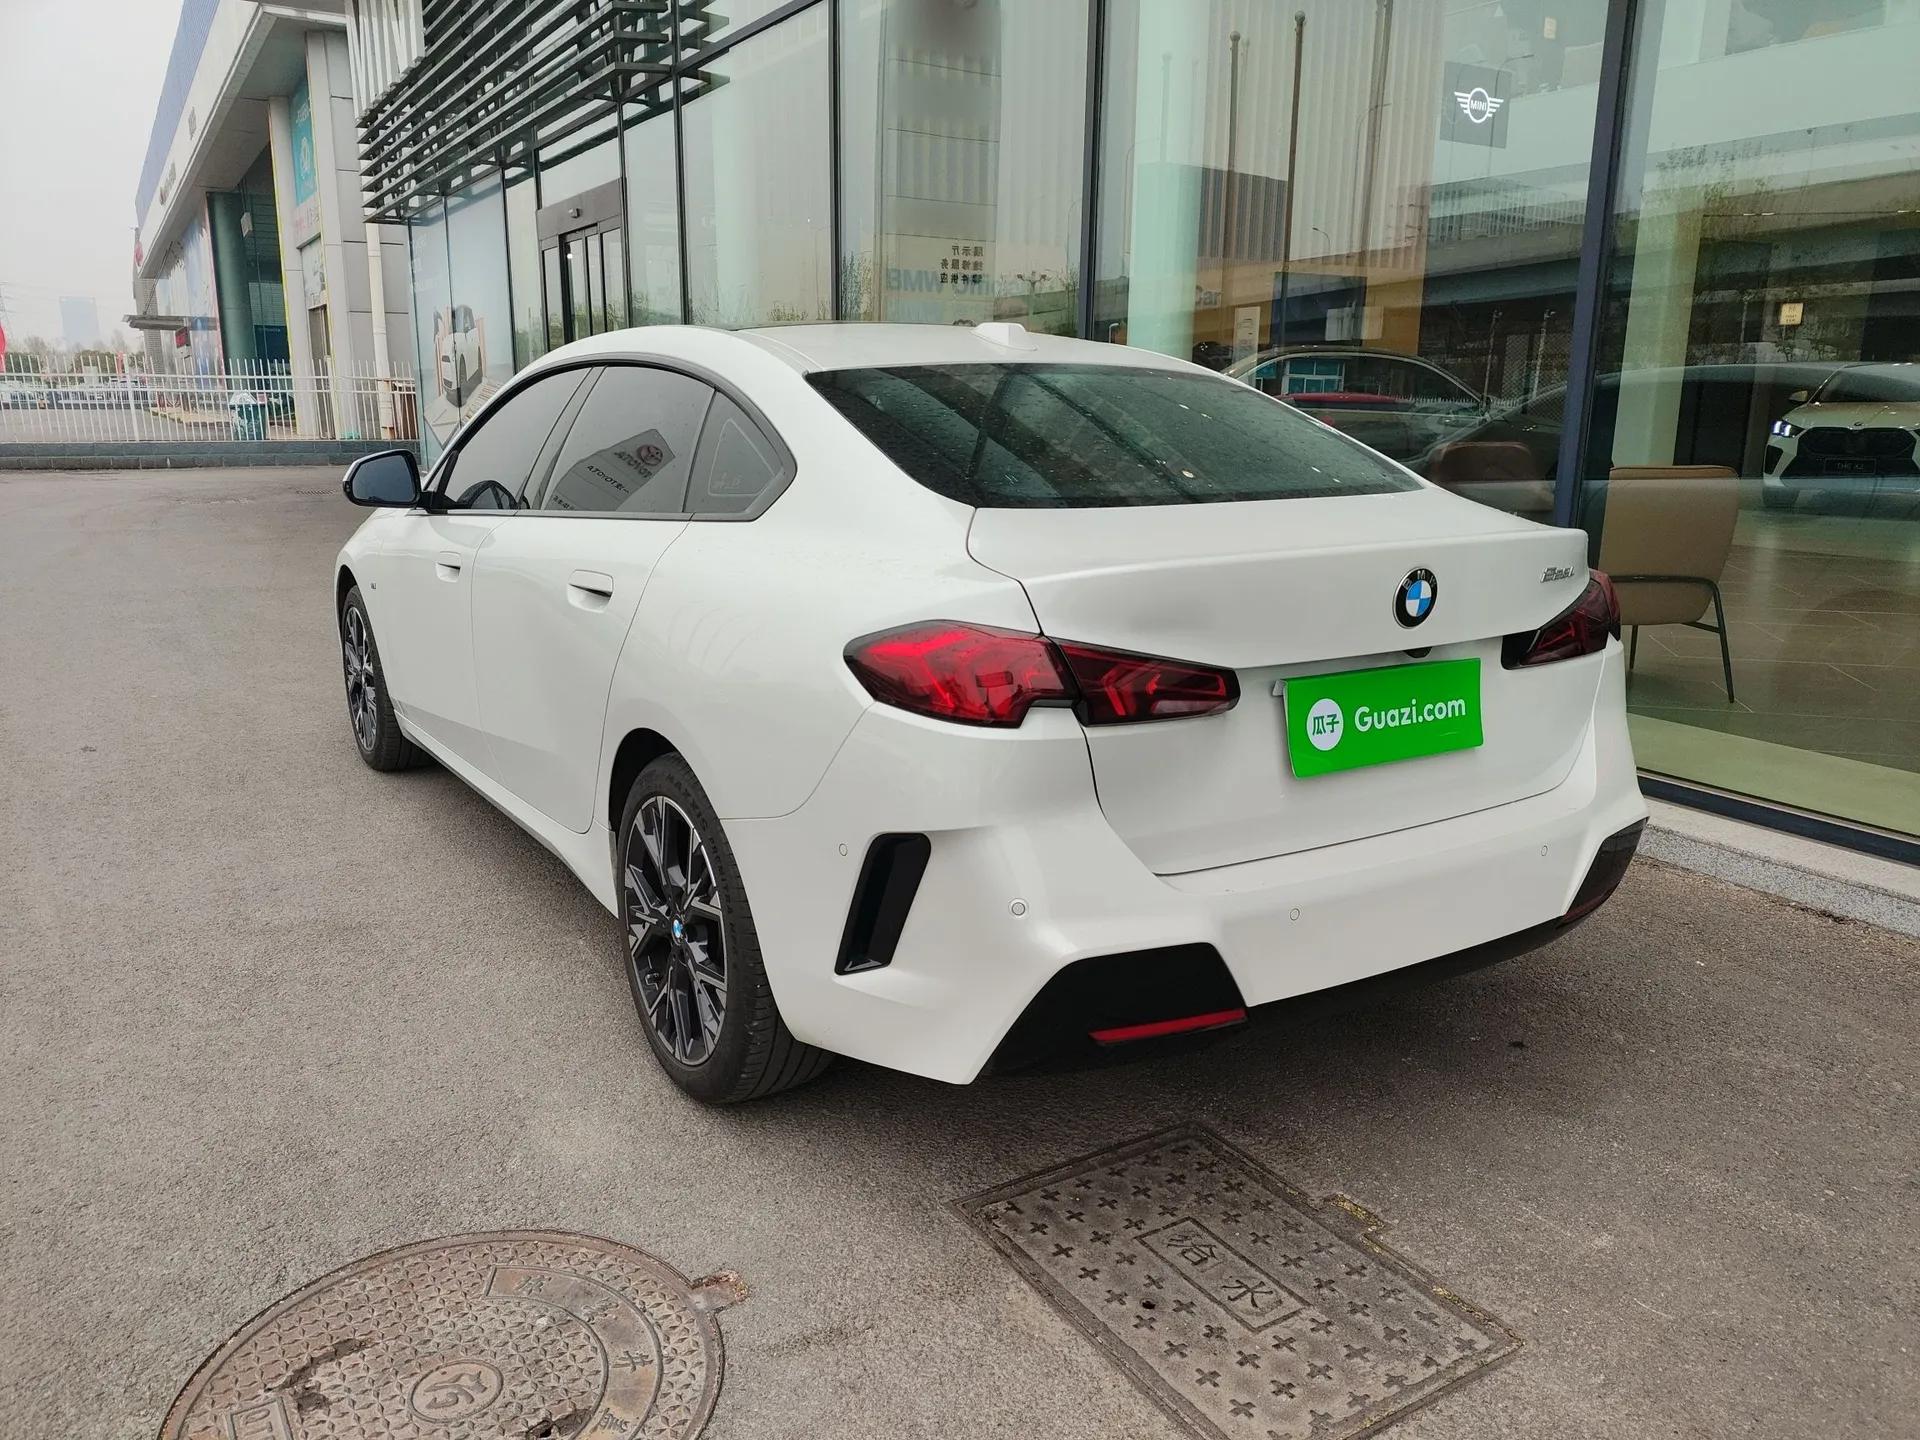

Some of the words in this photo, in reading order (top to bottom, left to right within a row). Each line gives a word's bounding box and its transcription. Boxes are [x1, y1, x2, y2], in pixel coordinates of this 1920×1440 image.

[1470, 99, 1487, 111] MINI
[1311, 713, 1340, 736] 瓜子
[1354, 696, 1467, 733] Guazi.com
